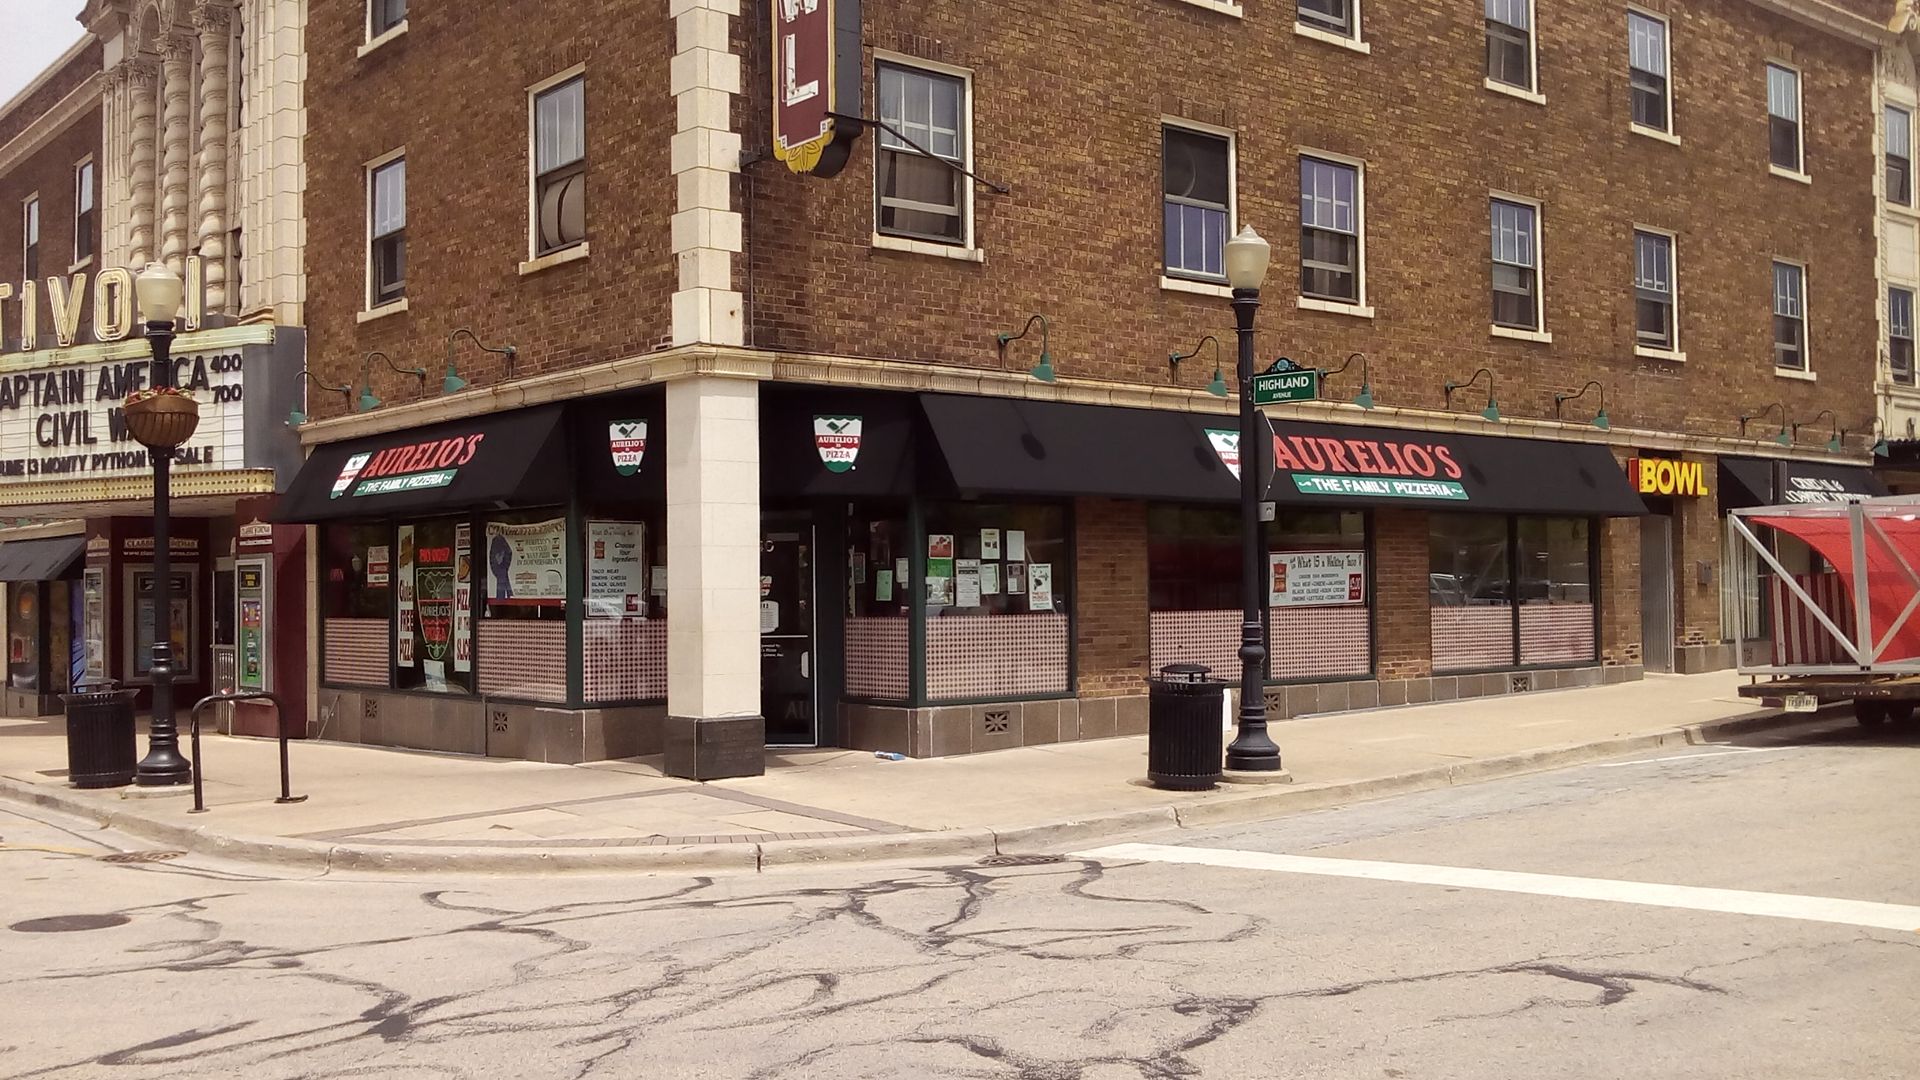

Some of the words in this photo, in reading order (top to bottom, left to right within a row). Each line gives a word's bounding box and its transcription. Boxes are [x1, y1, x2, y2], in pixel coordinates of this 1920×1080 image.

[0, 256, 200, 350] IVOI
[0, 368, 84, 410] APTAIN
[210, 354, 242, 373] 400
[1258, 376, 1309, 391] HIGHLAND
[211, 384, 243, 404] 700
[36, 410, 97, 447] CIVIL
[611, 440, 645, 448] AURELIO'S
[28, 458, 39, 475] 13
[41, 454, 87, 475] MONTY
[92, 450, 146, 471] PYTHON
[174, 445, 214, 465] SALE
[361, 433, 485, 478] AURELIO'S
[617, 454, 638, 463] PIZZA
[825, 450, 851, 459] PIZZA
[1274, 435, 1462, 479] AURELIO'S
[364, 482, 380, 493] THE
[379, 478, 409, 492] FAMILY
[408, 473, 444, 488] PIZZERIA
[1311, 477, 1340, 492] THE
[1341, 480, 1391, 493] FAMILY
[1394, 482, 1453, 496] PIZZERIA
[1639, 459, 1708, 495] BOWL
